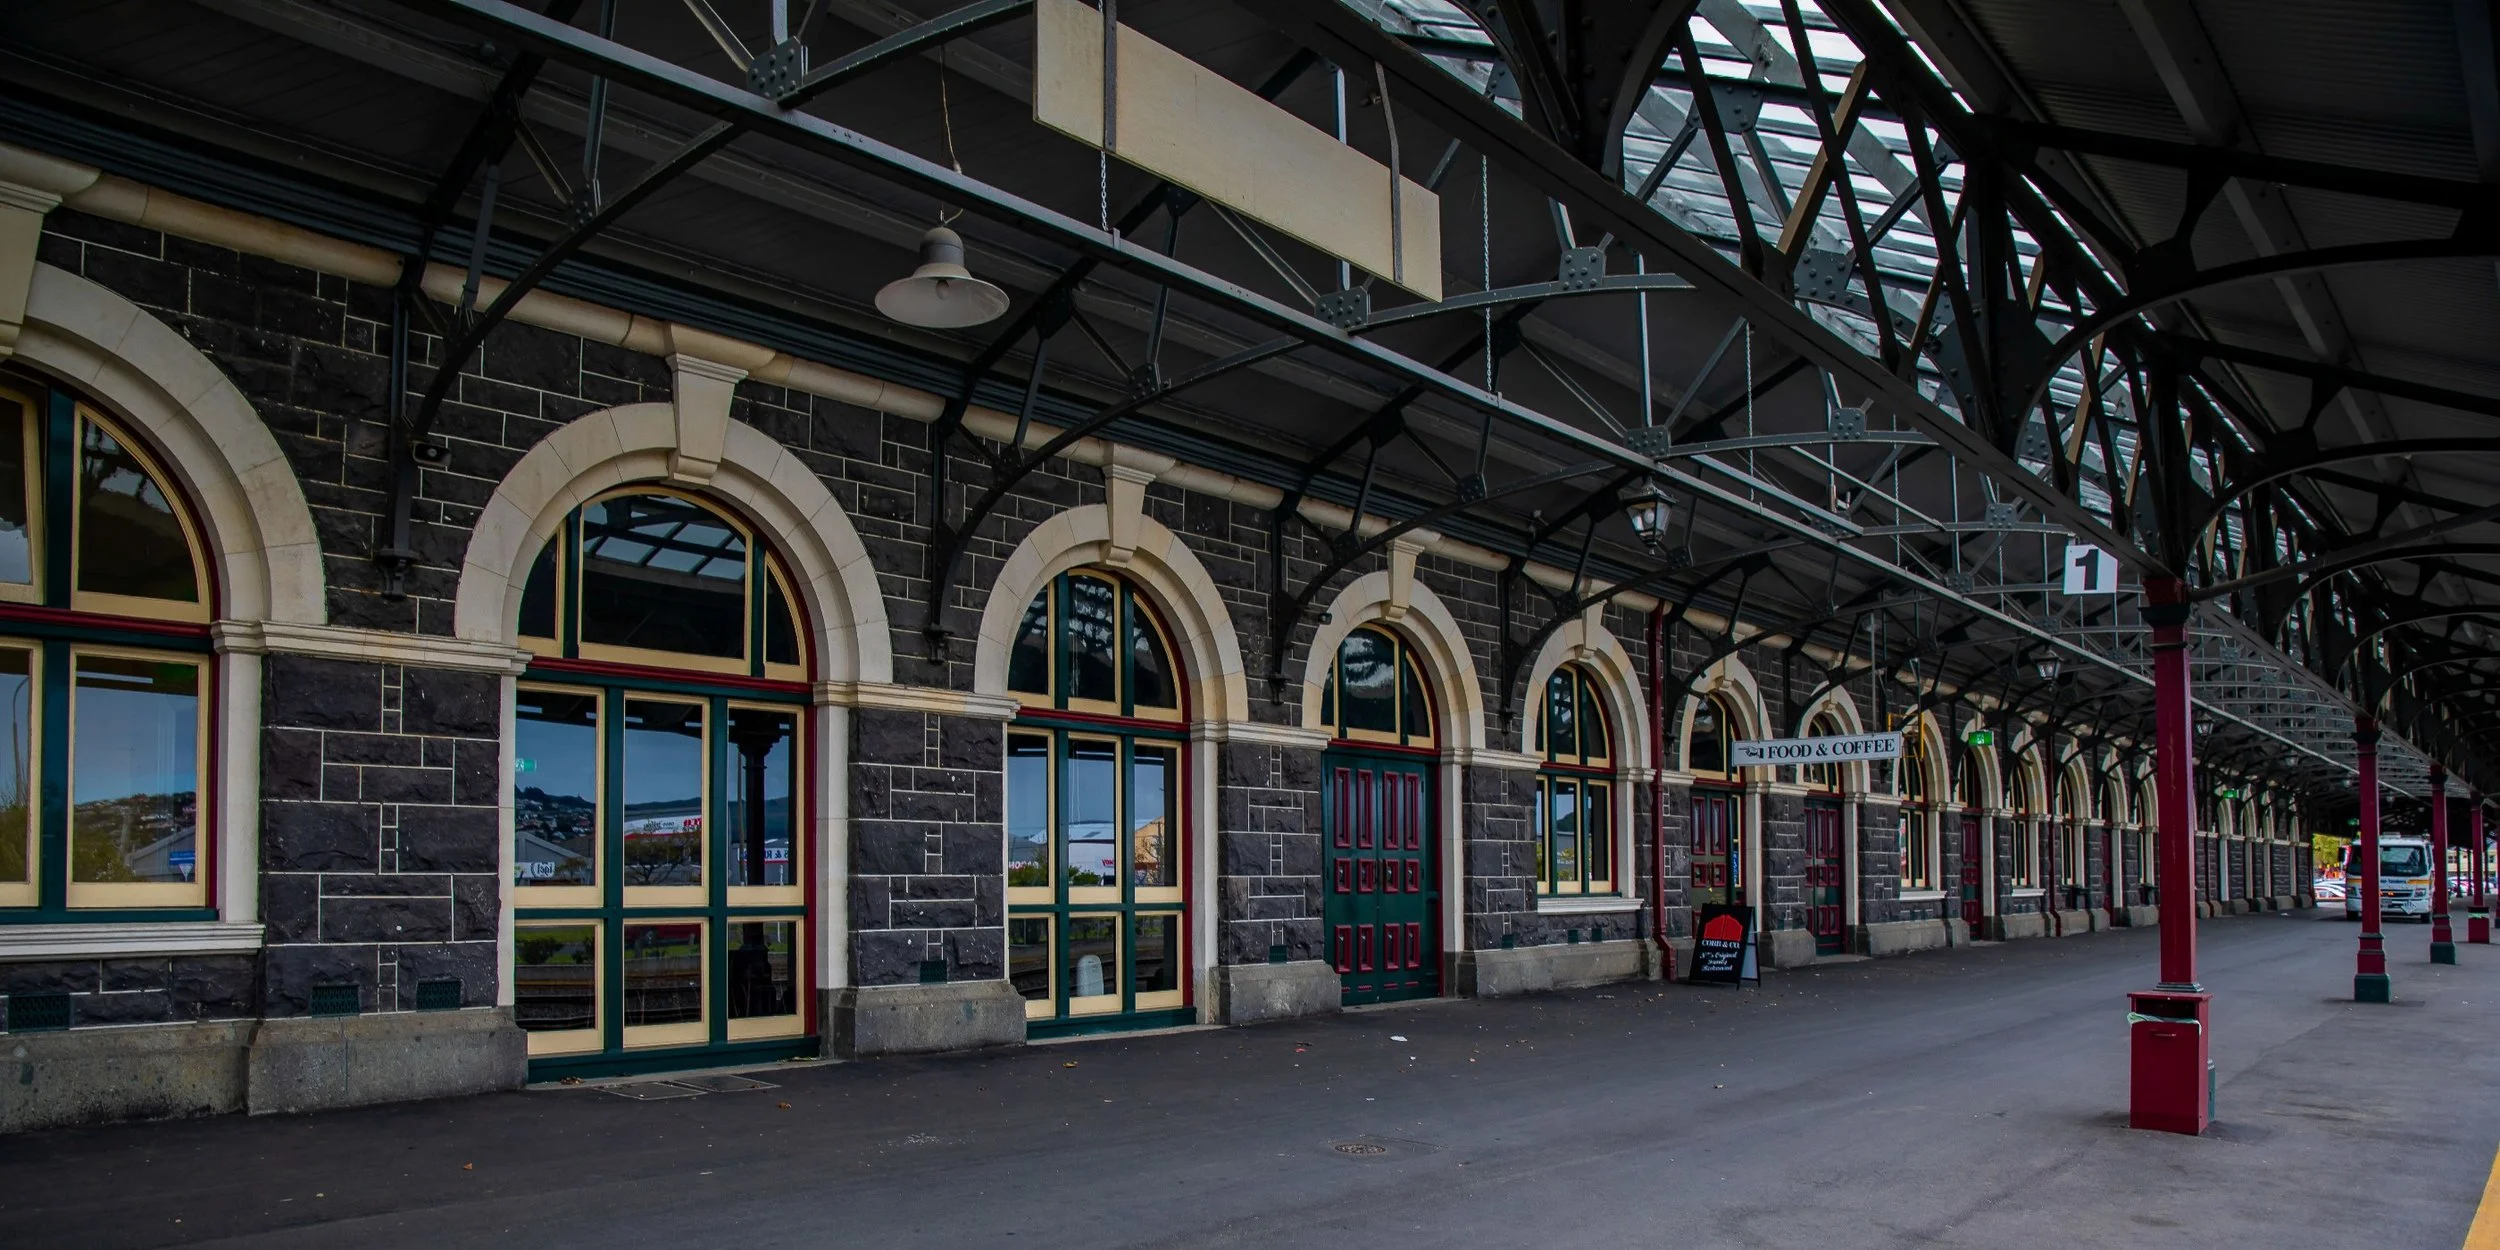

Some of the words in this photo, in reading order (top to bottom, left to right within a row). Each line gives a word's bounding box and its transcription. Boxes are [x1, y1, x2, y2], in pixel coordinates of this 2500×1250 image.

[2075, 548, 2099, 591] 1
[1768, 744, 1812, 759] FOOD
[1815, 743, 1828, 756] &
[1832, 738, 1895, 756] COFFEE
